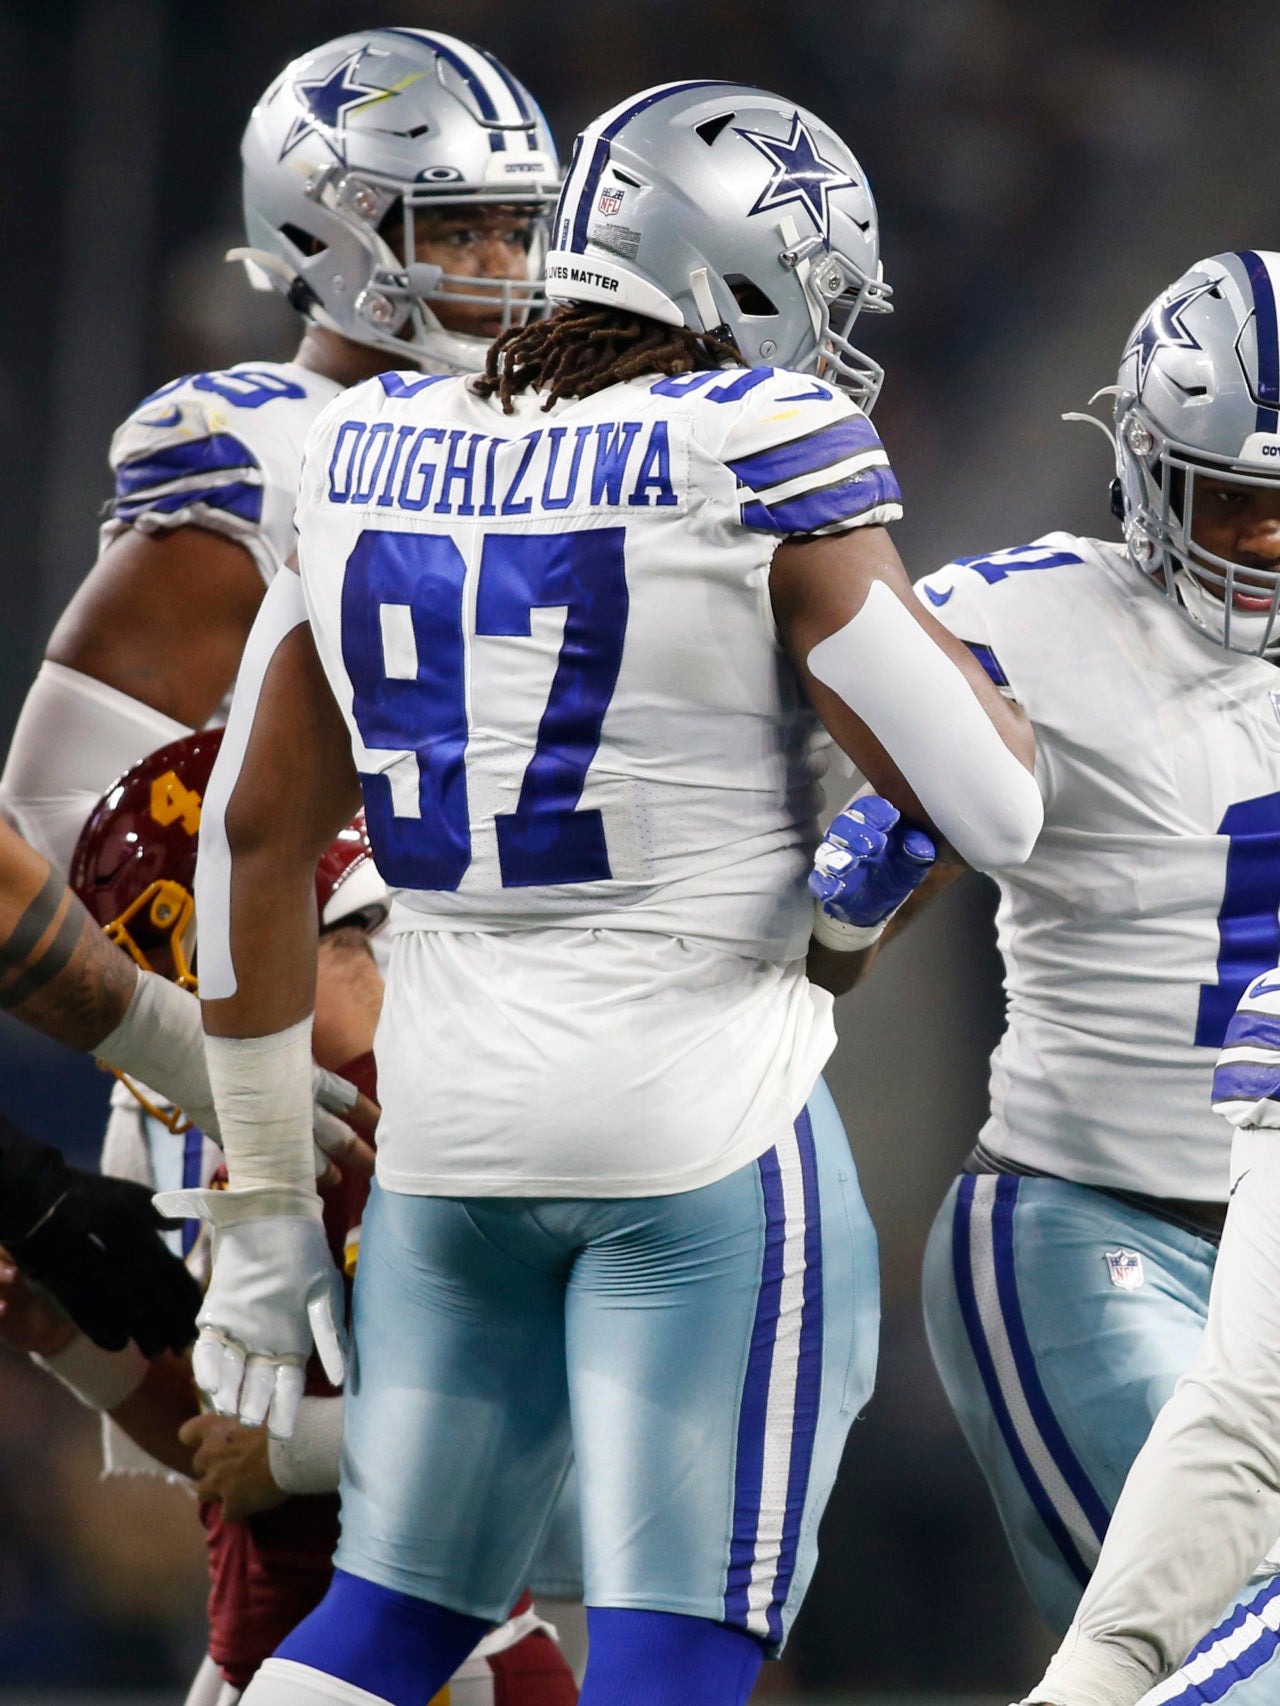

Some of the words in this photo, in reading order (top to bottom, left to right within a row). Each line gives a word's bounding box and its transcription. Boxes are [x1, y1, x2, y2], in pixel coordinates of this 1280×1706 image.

[549, 266, 568, 280] LIVES
[571, 268, 619, 292] MATTER
[328, 420, 678, 517] ODIGHIZUWA
[341, 527, 629, 892] 97
